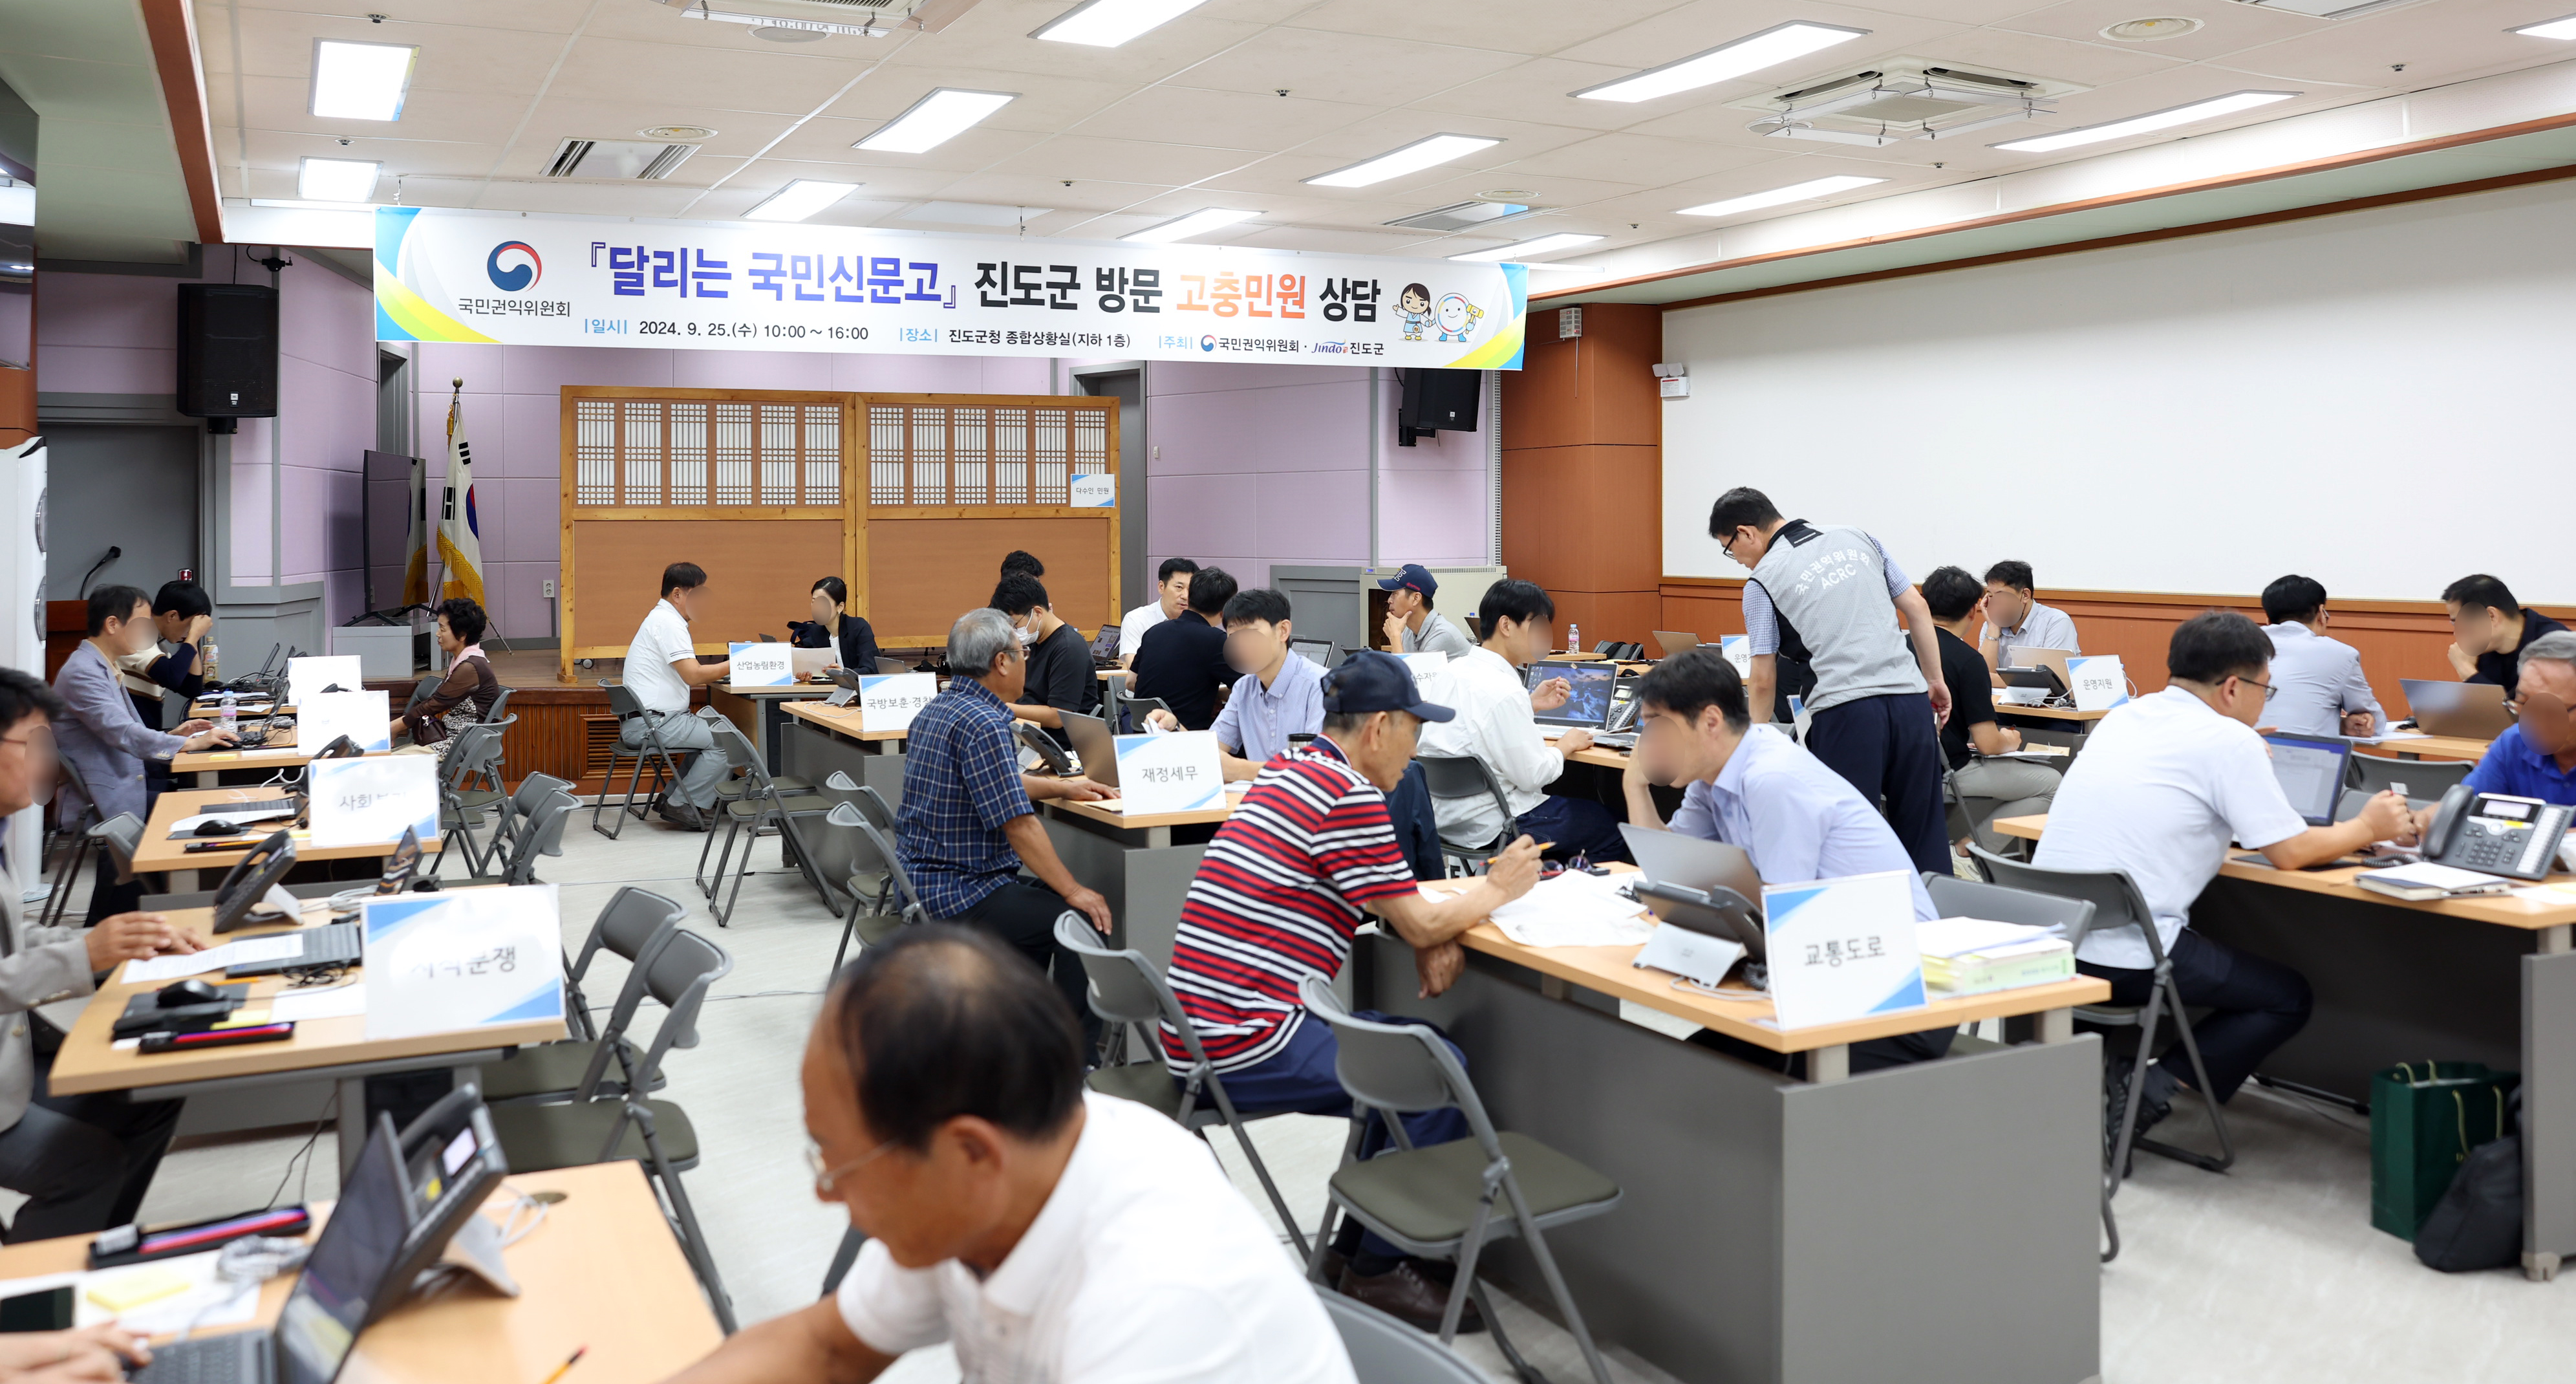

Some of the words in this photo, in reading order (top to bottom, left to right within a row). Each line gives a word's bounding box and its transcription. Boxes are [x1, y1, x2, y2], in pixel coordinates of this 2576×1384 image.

[591, 241, 731, 299] 『달리는
[748, 252, 957, 309] 국민신문고』
[974, 261, 1081, 310] 진도군
[1096, 266, 1163, 314] 방문
[1176, 272, 1306, 319] 고충민원
[1319, 277, 1381, 323] 상담
[458, 297, 570, 318] 국민권익위원회
[639, 321, 681, 336] 2024.
[687, 322, 701, 336] 9.
[764, 324, 806, 338] 10:00
[828, 326, 869, 340] 16:00
[949, 329, 1001, 345] 진도군청
[1005, 330, 1102, 347] 종합상황실(지하
[1106, 334, 1131, 349] 1층)
[1218, 338, 1299, 353] 국민권익위원회
[1349, 342, 1384, 356] 진도군
[1794, 548, 1870, 596] 국민권익위원회
[1821, 563, 1856, 590] ACRC
[736, 660, 784, 670] 산업농림환경
[2083, 678, 2113, 690] 운영지원
[1142, 766, 1198, 783] 재정세무
[1804, 936, 1886, 968] 교통도로
